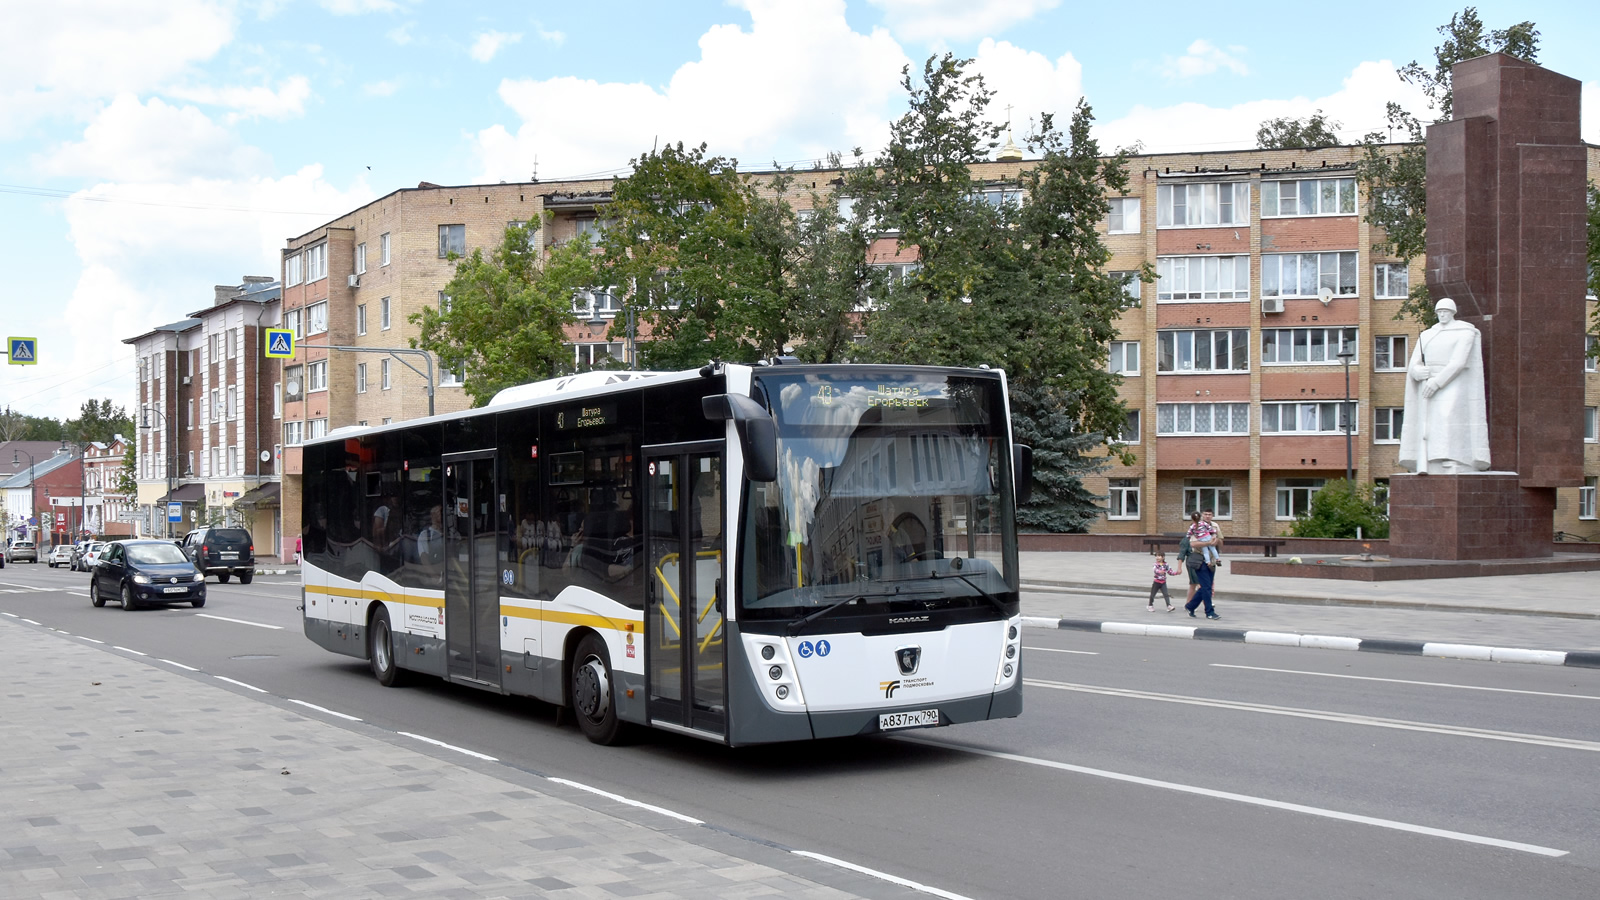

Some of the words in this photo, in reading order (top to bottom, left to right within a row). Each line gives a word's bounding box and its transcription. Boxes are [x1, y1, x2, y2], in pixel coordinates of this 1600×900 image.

[817, 385, 832, 405] 43
[877, 384, 919, 396] Шатура
[867, 395, 929, 407] Егорьевск
[577, 416, 606, 428] Егорьевск
[922, 710, 936, 720] 790
